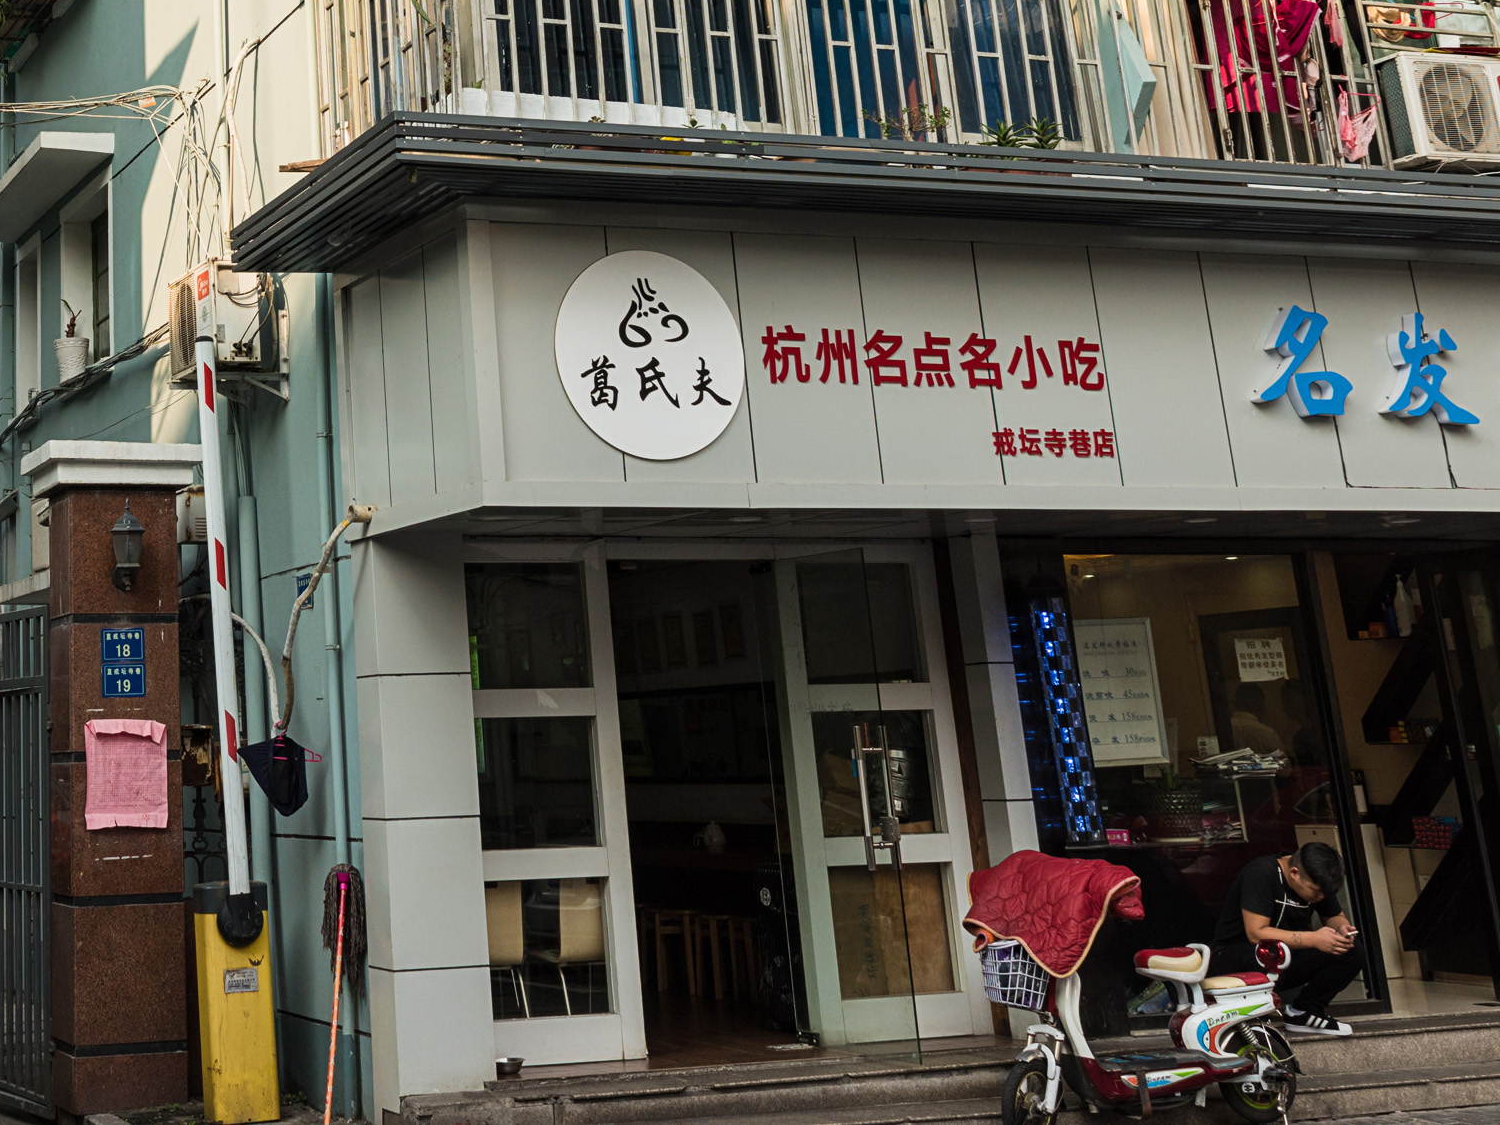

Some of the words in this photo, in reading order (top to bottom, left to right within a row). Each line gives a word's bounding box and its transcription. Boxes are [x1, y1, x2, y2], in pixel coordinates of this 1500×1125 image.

[761, 325, 1106, 392] 杭州名点名小吃
[1257, 304, 1481, 425] 名发
[581, 355, 732, 411] 葛氏夫
[992, 427, 1115, 458] 戒坛寺巷店
[115, 644, 131, 657] 18
[116, 679, 131, 692] 19
